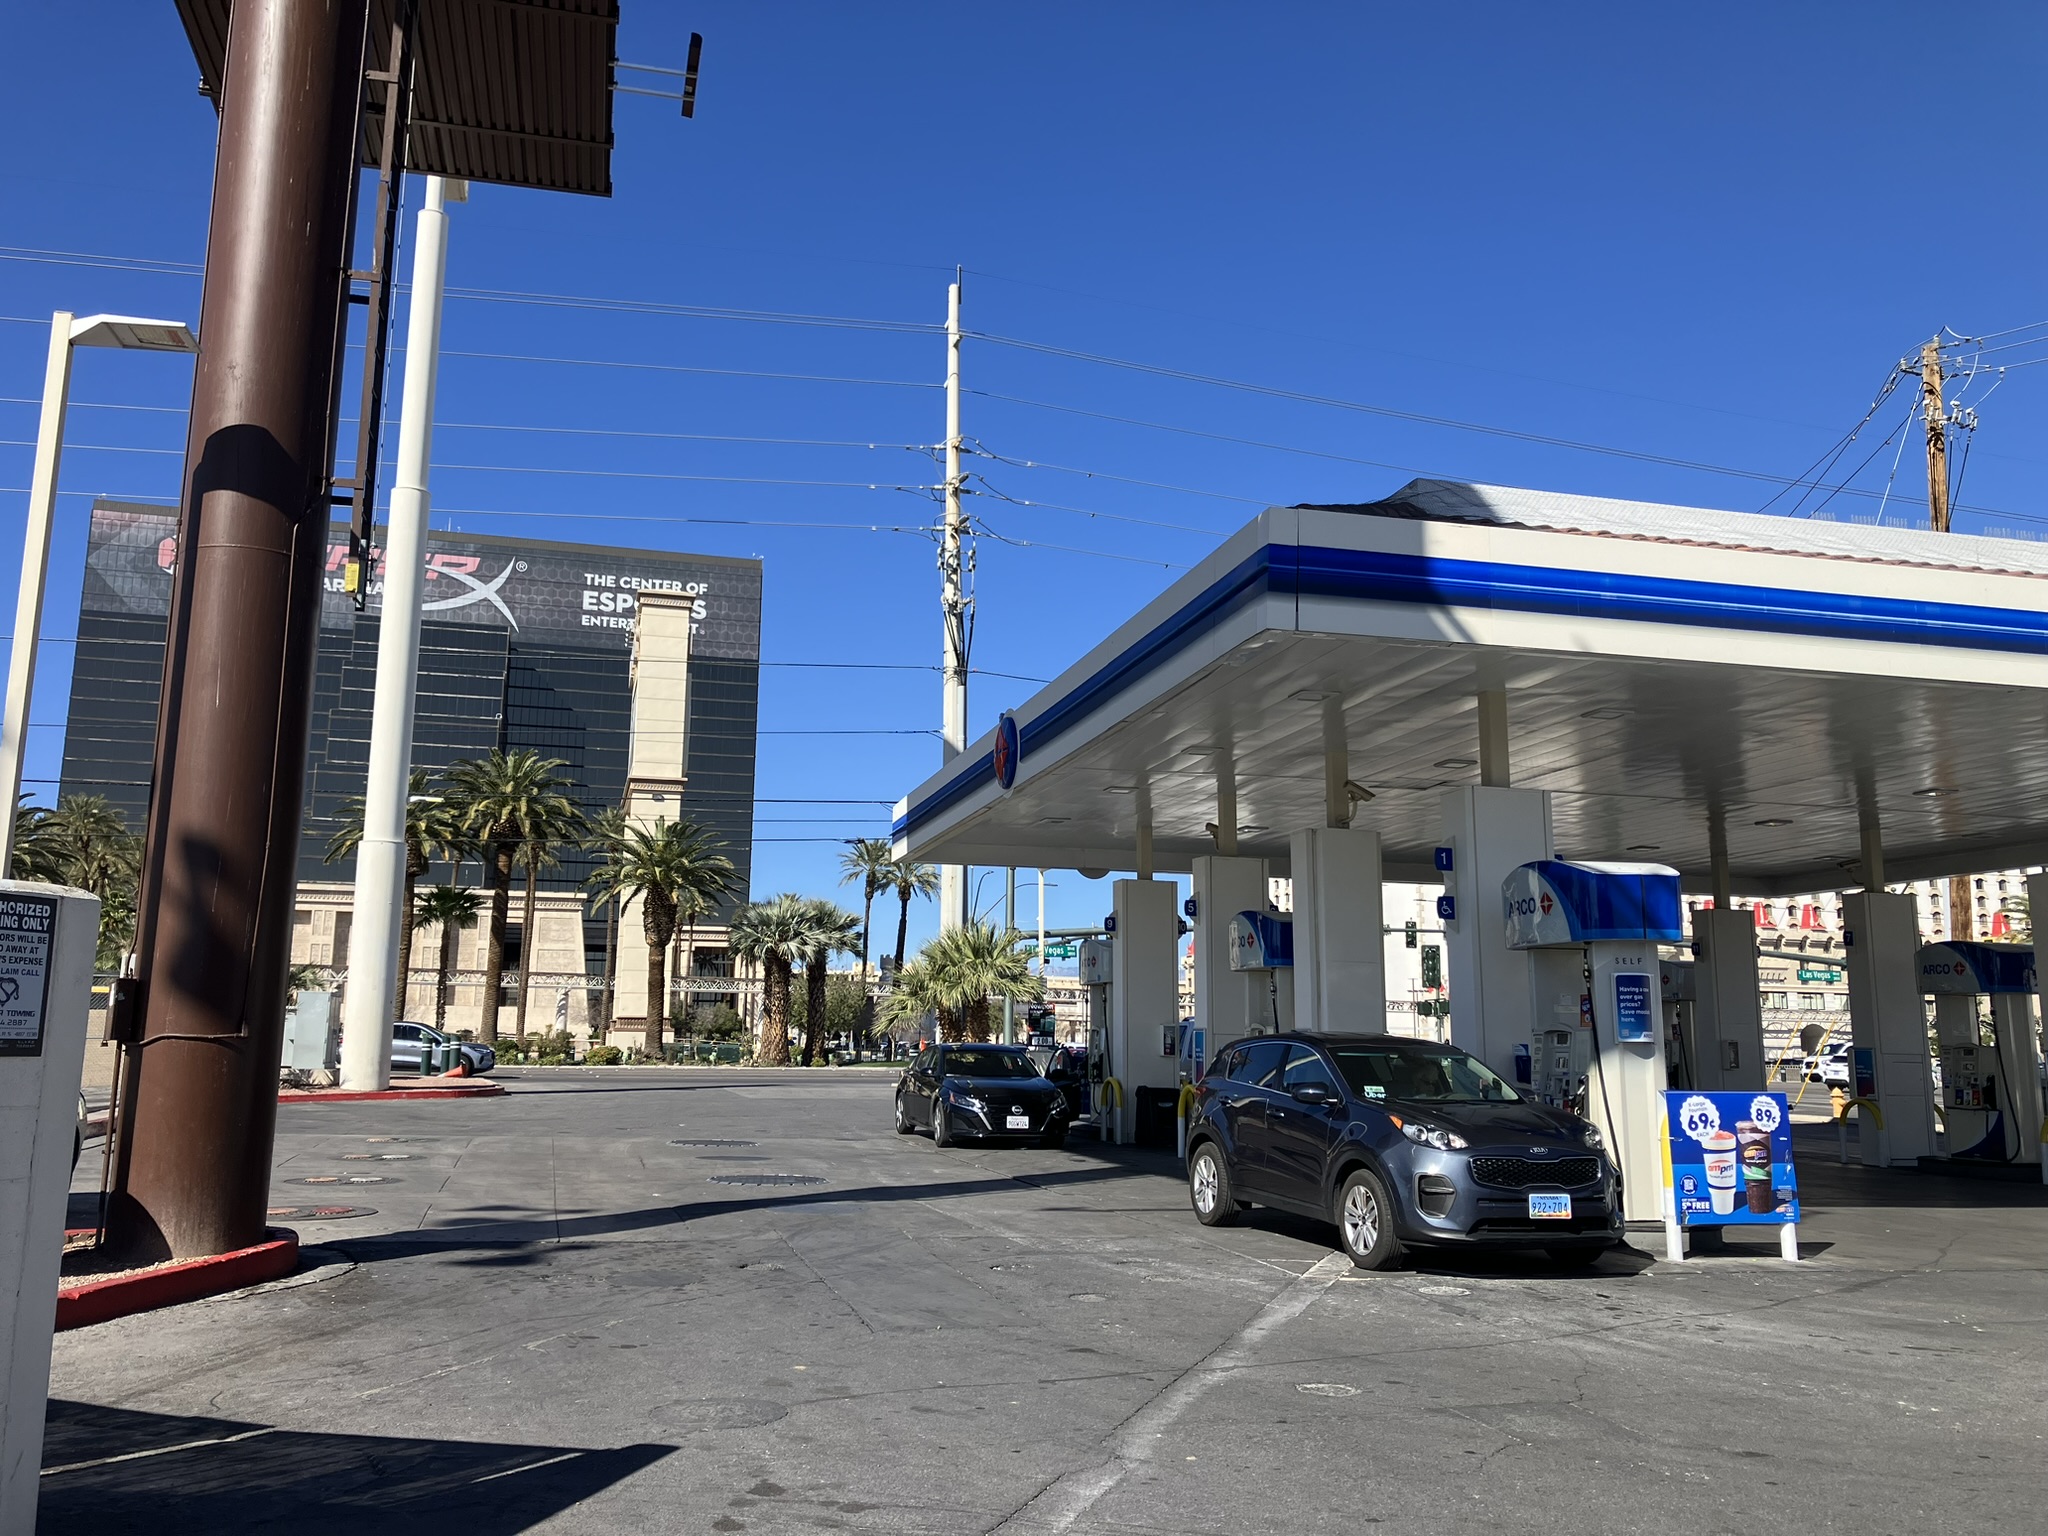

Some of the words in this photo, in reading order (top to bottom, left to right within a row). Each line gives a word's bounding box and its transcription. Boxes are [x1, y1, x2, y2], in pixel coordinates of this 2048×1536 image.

[584, 573, 616, 587] THE
[619, 576, 682, 591] CENTER
[686, 582, 708, 594] OF
[582, 591, 708, 620] ESPS
[1440, 851, 1447, 865] 1
[1187, 903, 1194, 912] 5
[1508, 897, 1536, 918] ARCO
[22, 917, 49, 931] ONLY
[1106, 919, 1113, 928] 9
[17, 935, 35, 944] WILL
[37, 936, 47, 945] BE
[5, 945, 27, 954] AWAY
[29, 947, 39, 955] AT
[1044, 946, 1065, 957] Vegas
[9, 956, 43, 966] EXPENSE
[1615, 957, 1642, 965] SELF
[21, 968, 40, 976] CALL
[1923, 963, 1951, 975] ARCO
[1802, 970, 1813, 979] Las
[1813, 971, 1831, 981] Vegas
[7, 1009, 35, 1018] TOWING
[1364, 1091, 1387, 1099] Uber
[1755, 1108, 1777, 1123] 89¢
[1688, 1112, 1716, 1131] 69¢
[1708, 1164, 1734, 1175] ampm
[1692, 1201, 1710, 1209] FREE
